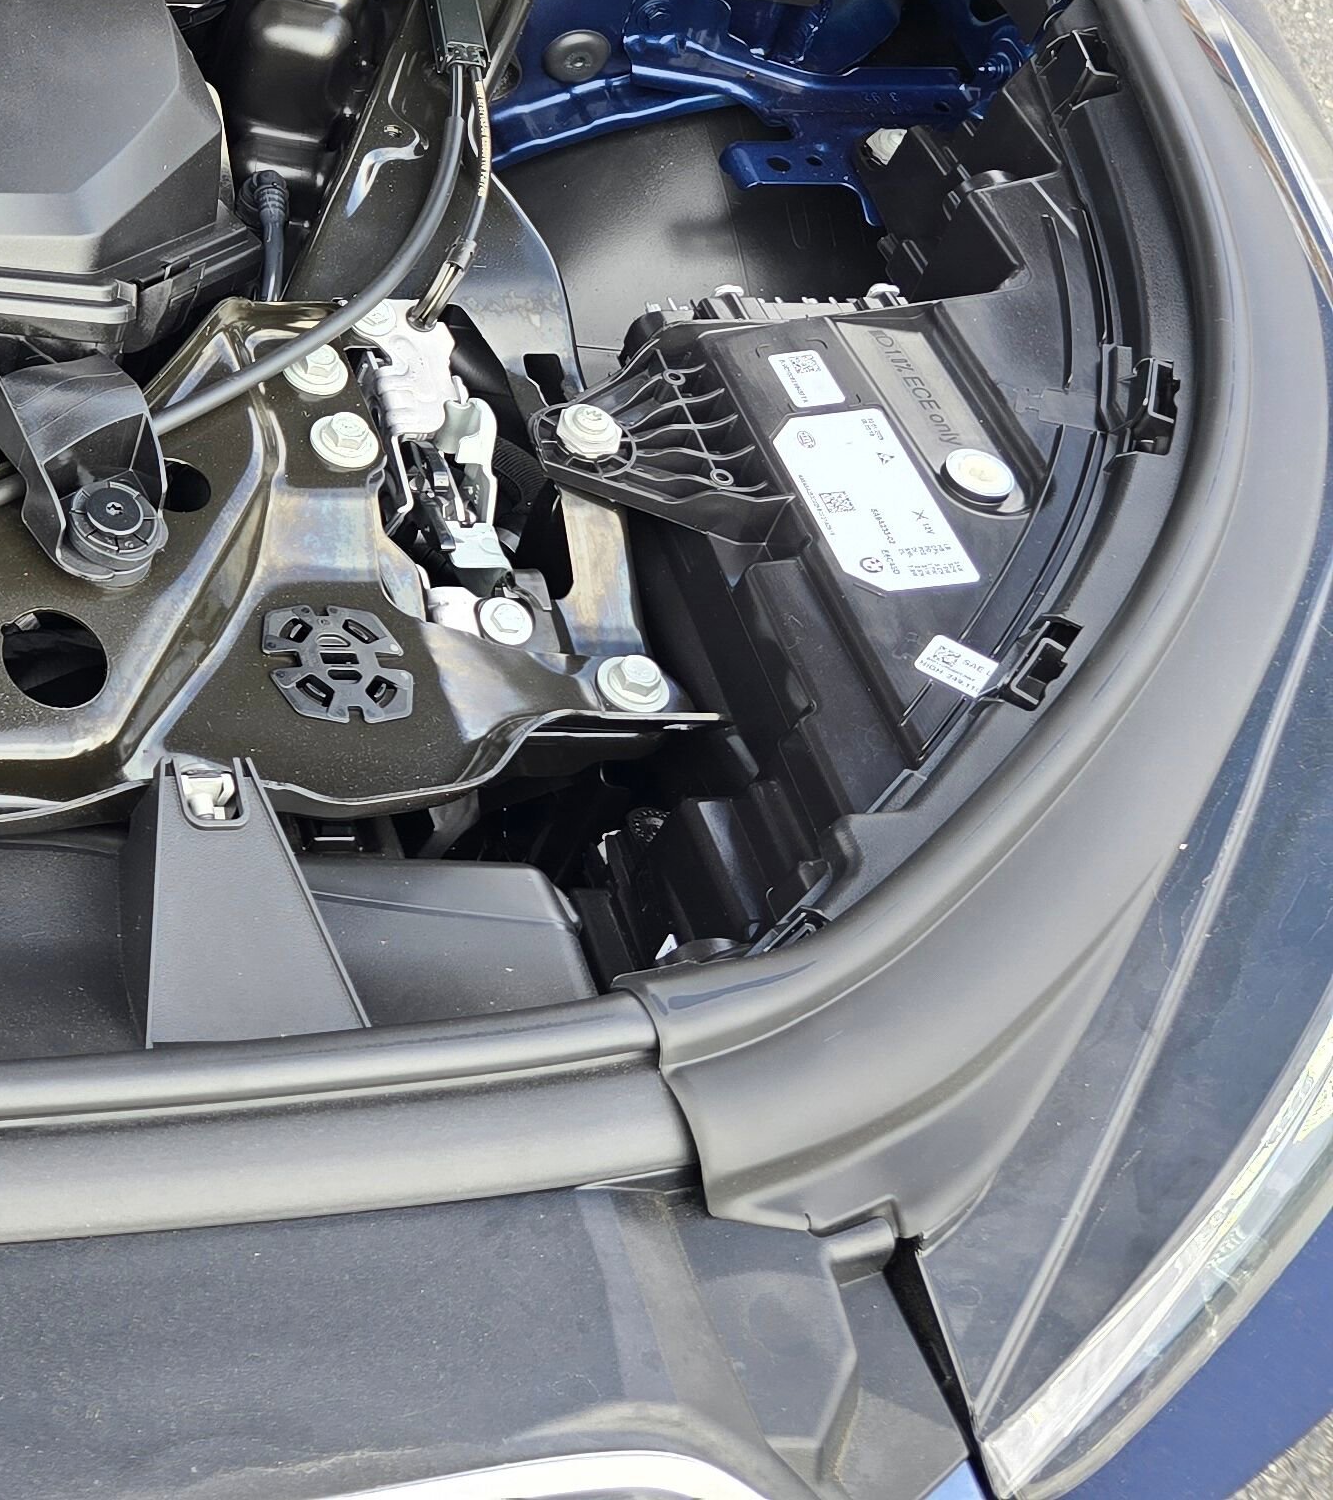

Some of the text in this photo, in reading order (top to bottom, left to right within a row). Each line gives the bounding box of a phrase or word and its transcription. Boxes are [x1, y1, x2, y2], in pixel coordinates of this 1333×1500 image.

[902, 376, 941, 411] ECE
[929, 413, 962, 446] only
[963, 660, 985, 673] SAE
